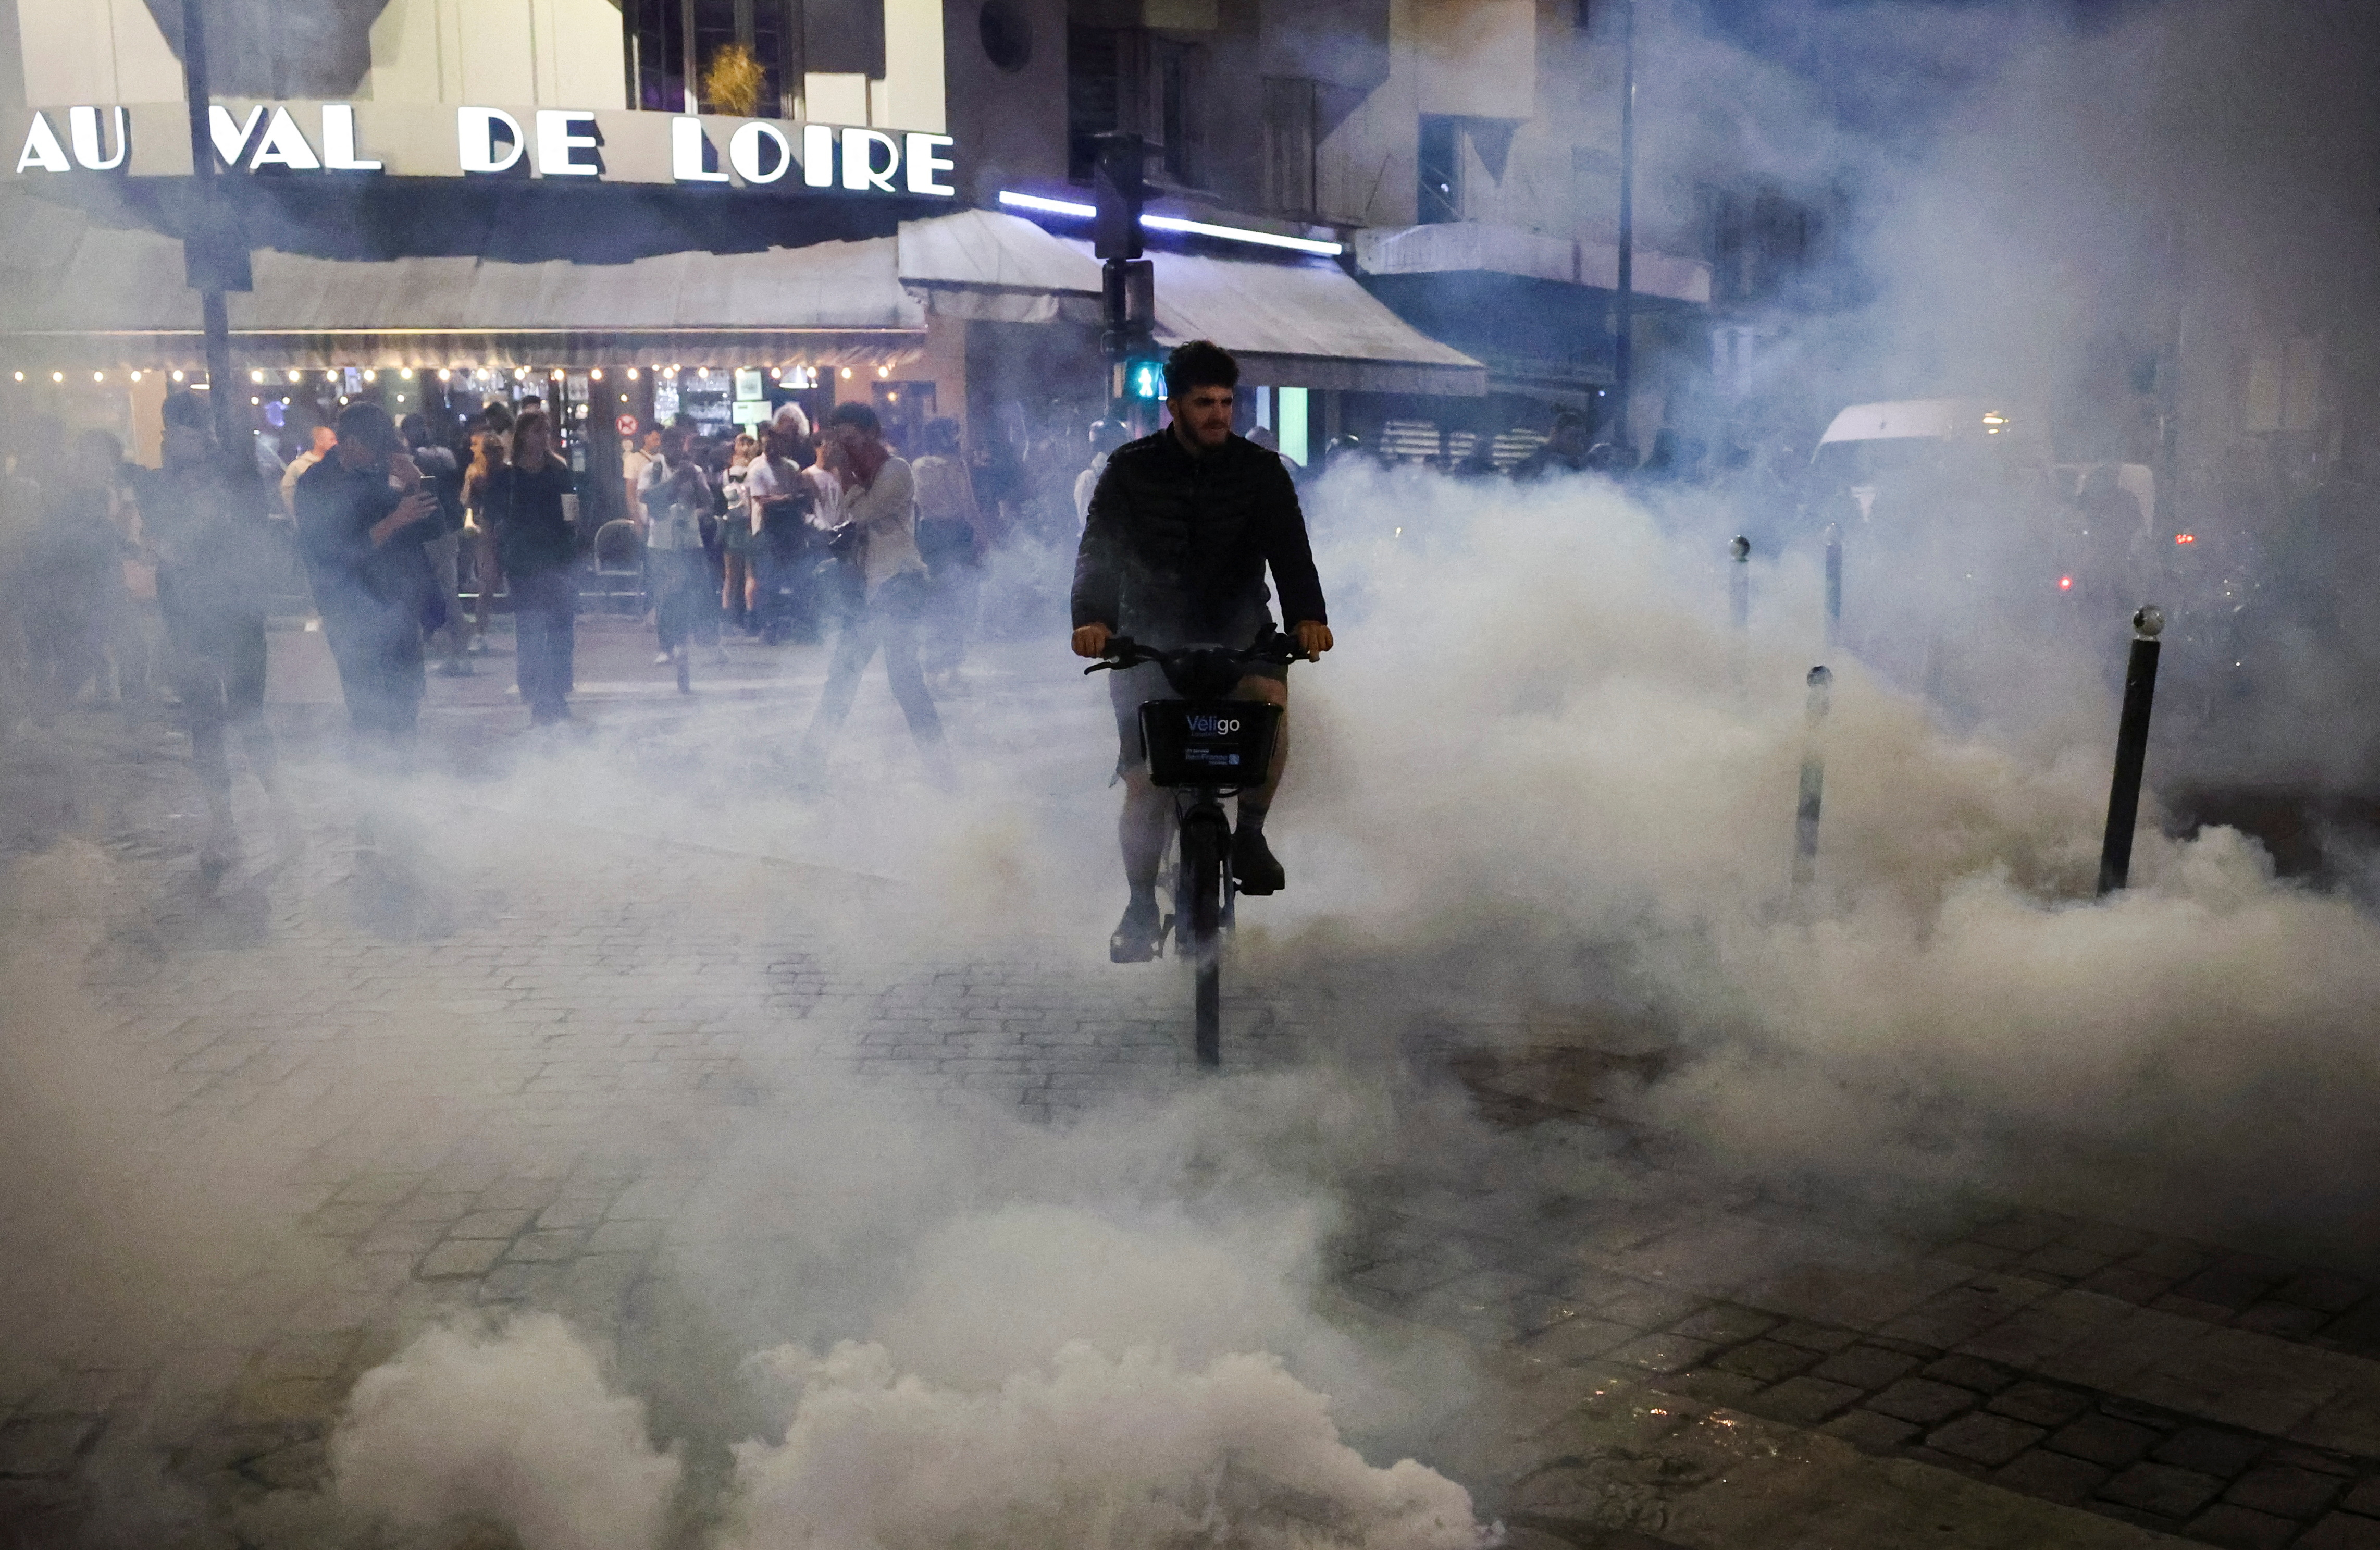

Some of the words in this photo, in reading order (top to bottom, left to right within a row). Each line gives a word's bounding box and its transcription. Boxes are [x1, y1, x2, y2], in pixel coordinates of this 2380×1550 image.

[16, 106, 126, 173] AU
[208, 104, 382, 170] VAL
[457, 106, 598, 175] DE
[672, 116, 955, 196] LOIRE
[1186, 715, 1240, 735] Véligo
